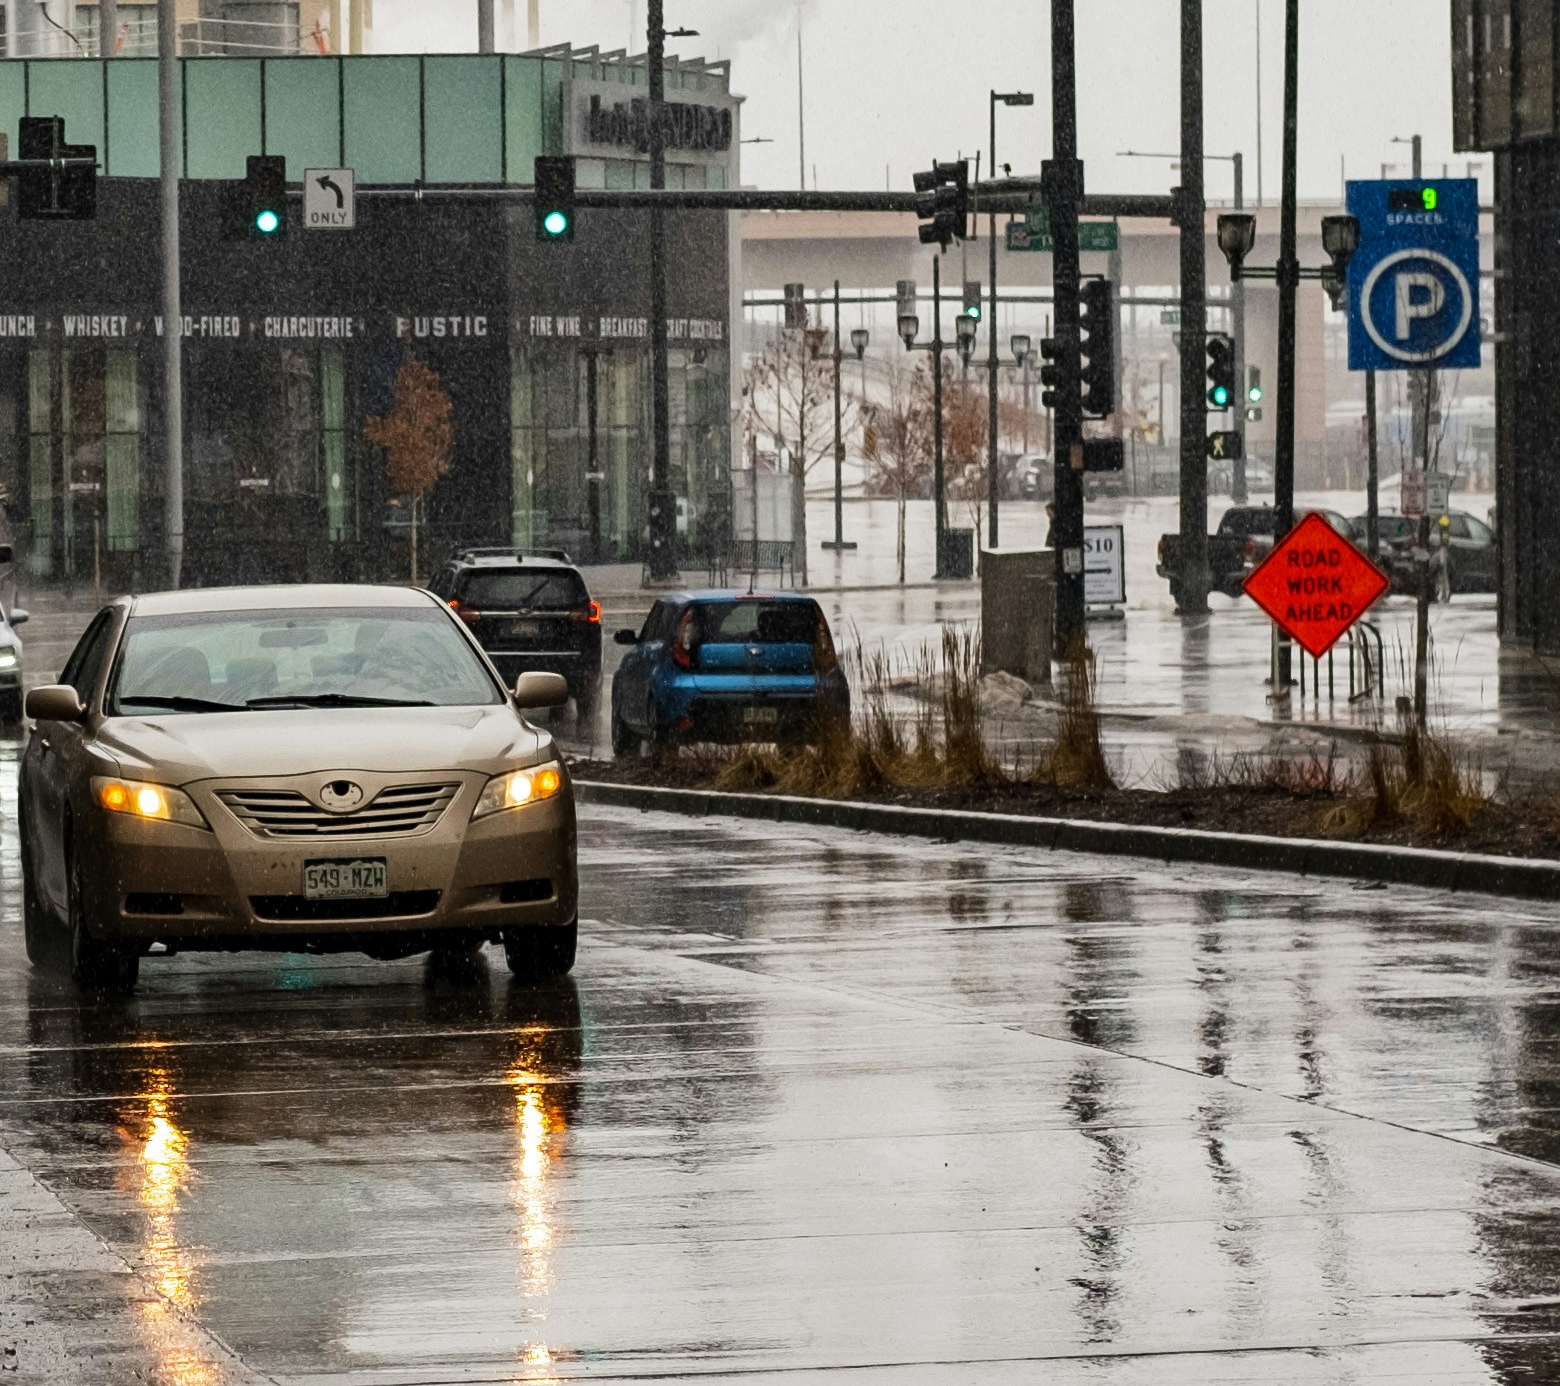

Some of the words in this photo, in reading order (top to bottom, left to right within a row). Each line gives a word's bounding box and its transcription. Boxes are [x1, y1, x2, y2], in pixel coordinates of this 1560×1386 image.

[1422, 188, 1437, 210] 9
[311, 213, 347, 224] ONLY
[1386, 215, 1443, 225] SPACES
[63, 315, 128, 337] WHISKEY
[154, 316, 240, 337] WD-FIRED
[264, 316, 353, 337] CHARCUTERIE
[530, 315, 553, 336] FINE
[556, 315, 580, 336] WINE
[600, 316, 648, 337] BREAKFAST
[1084, 538, 1113, 553] $10
[1287, 550, 1341, 568] ROAD
[1287, 576, 1343, 595] WORK
[1285, 603, 1352, 622] AHEAD
